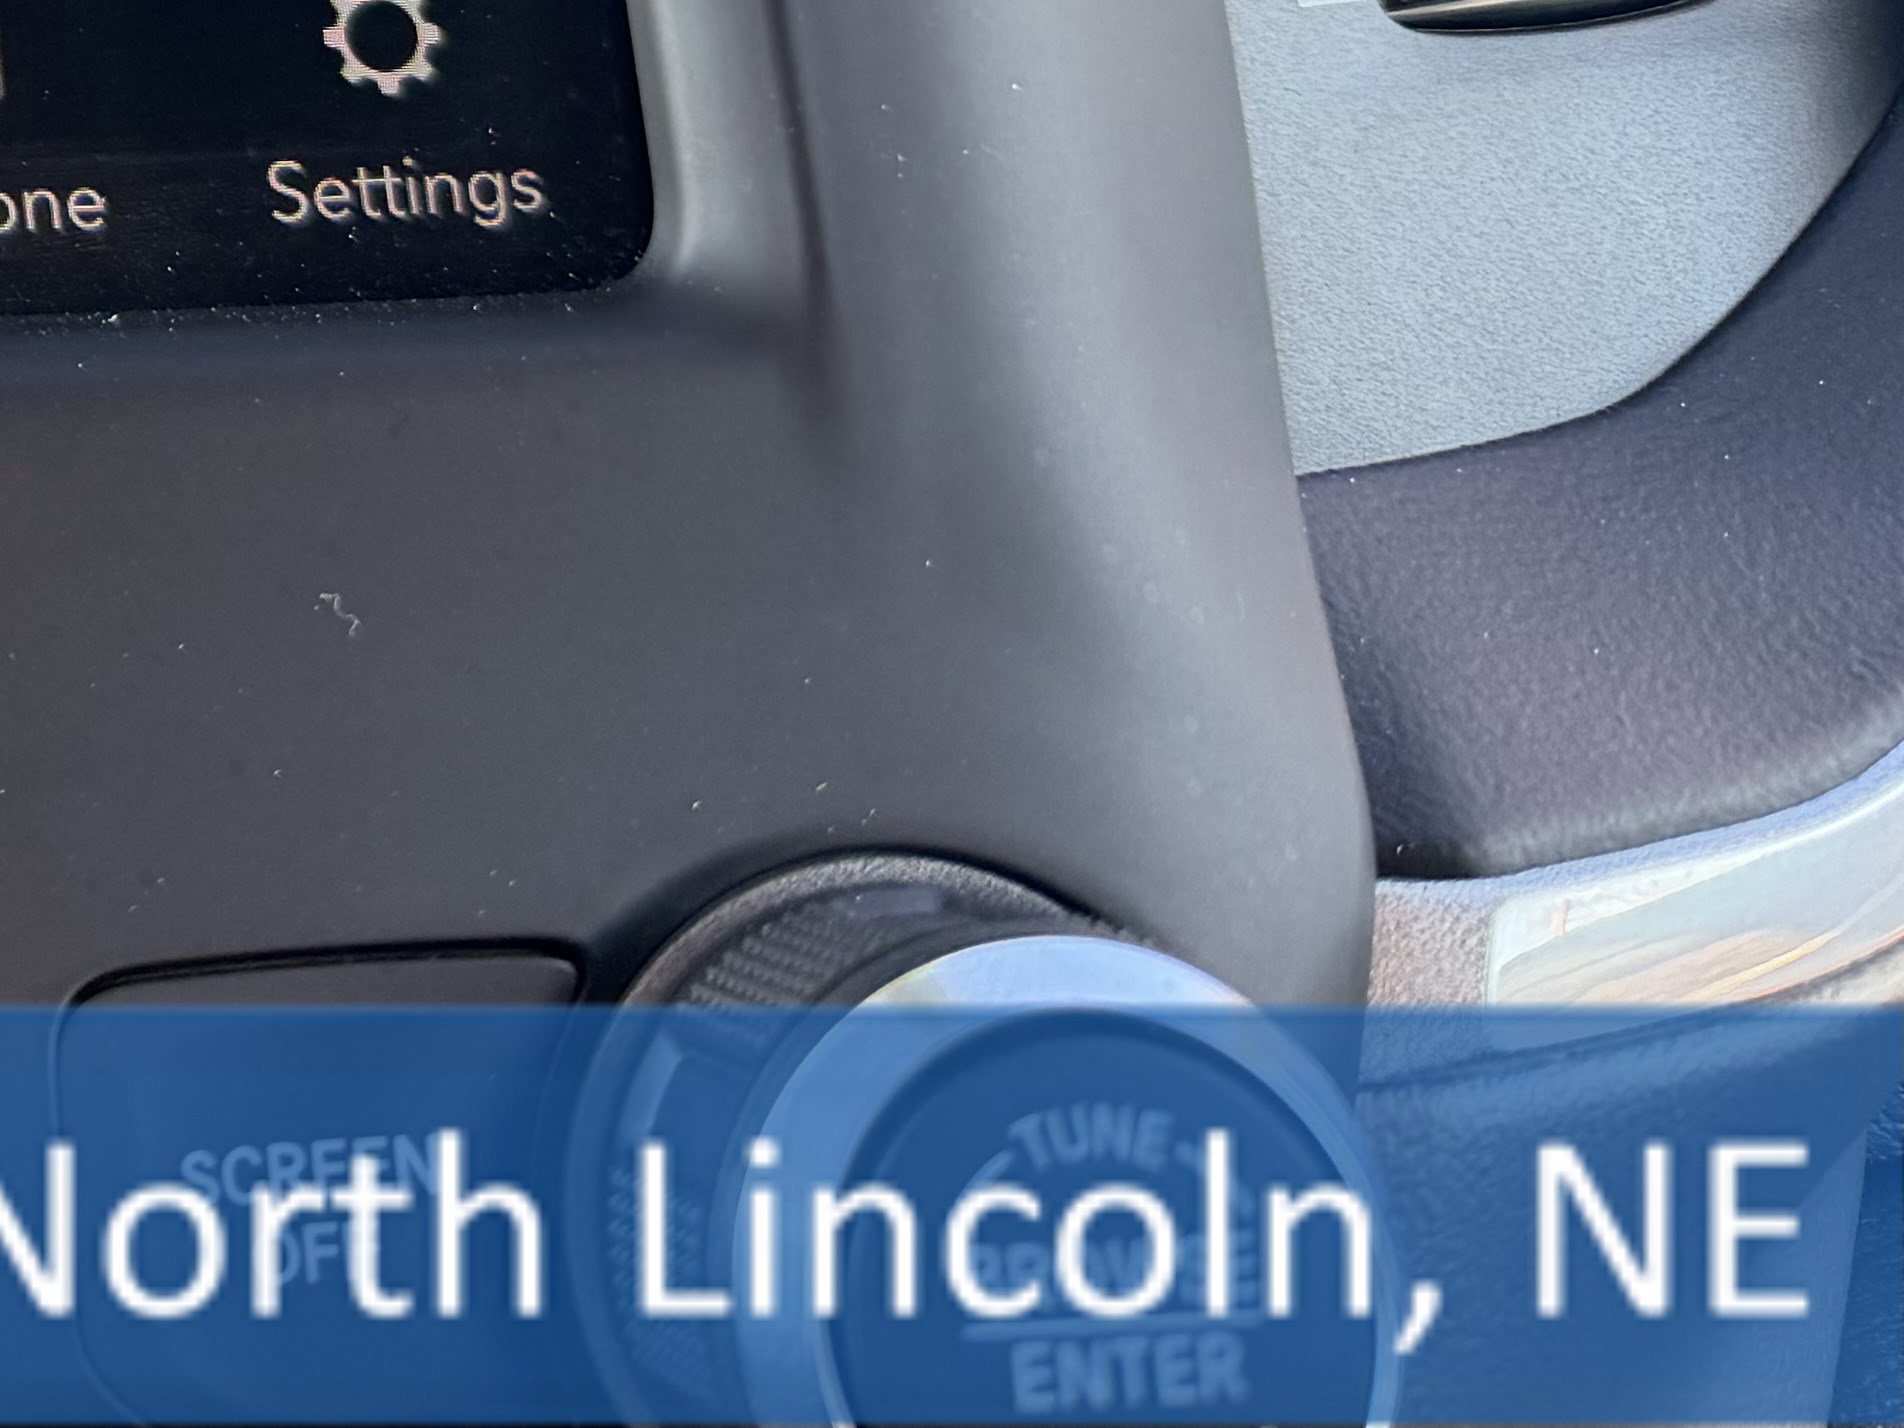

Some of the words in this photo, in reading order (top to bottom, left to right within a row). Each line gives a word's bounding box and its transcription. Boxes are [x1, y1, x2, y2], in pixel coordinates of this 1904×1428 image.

[267, 156, 544, 228] Settings
[1006, 1101, 1174, 1174] TUNE
[1009, 1332, 1250, 1416] ENTER
